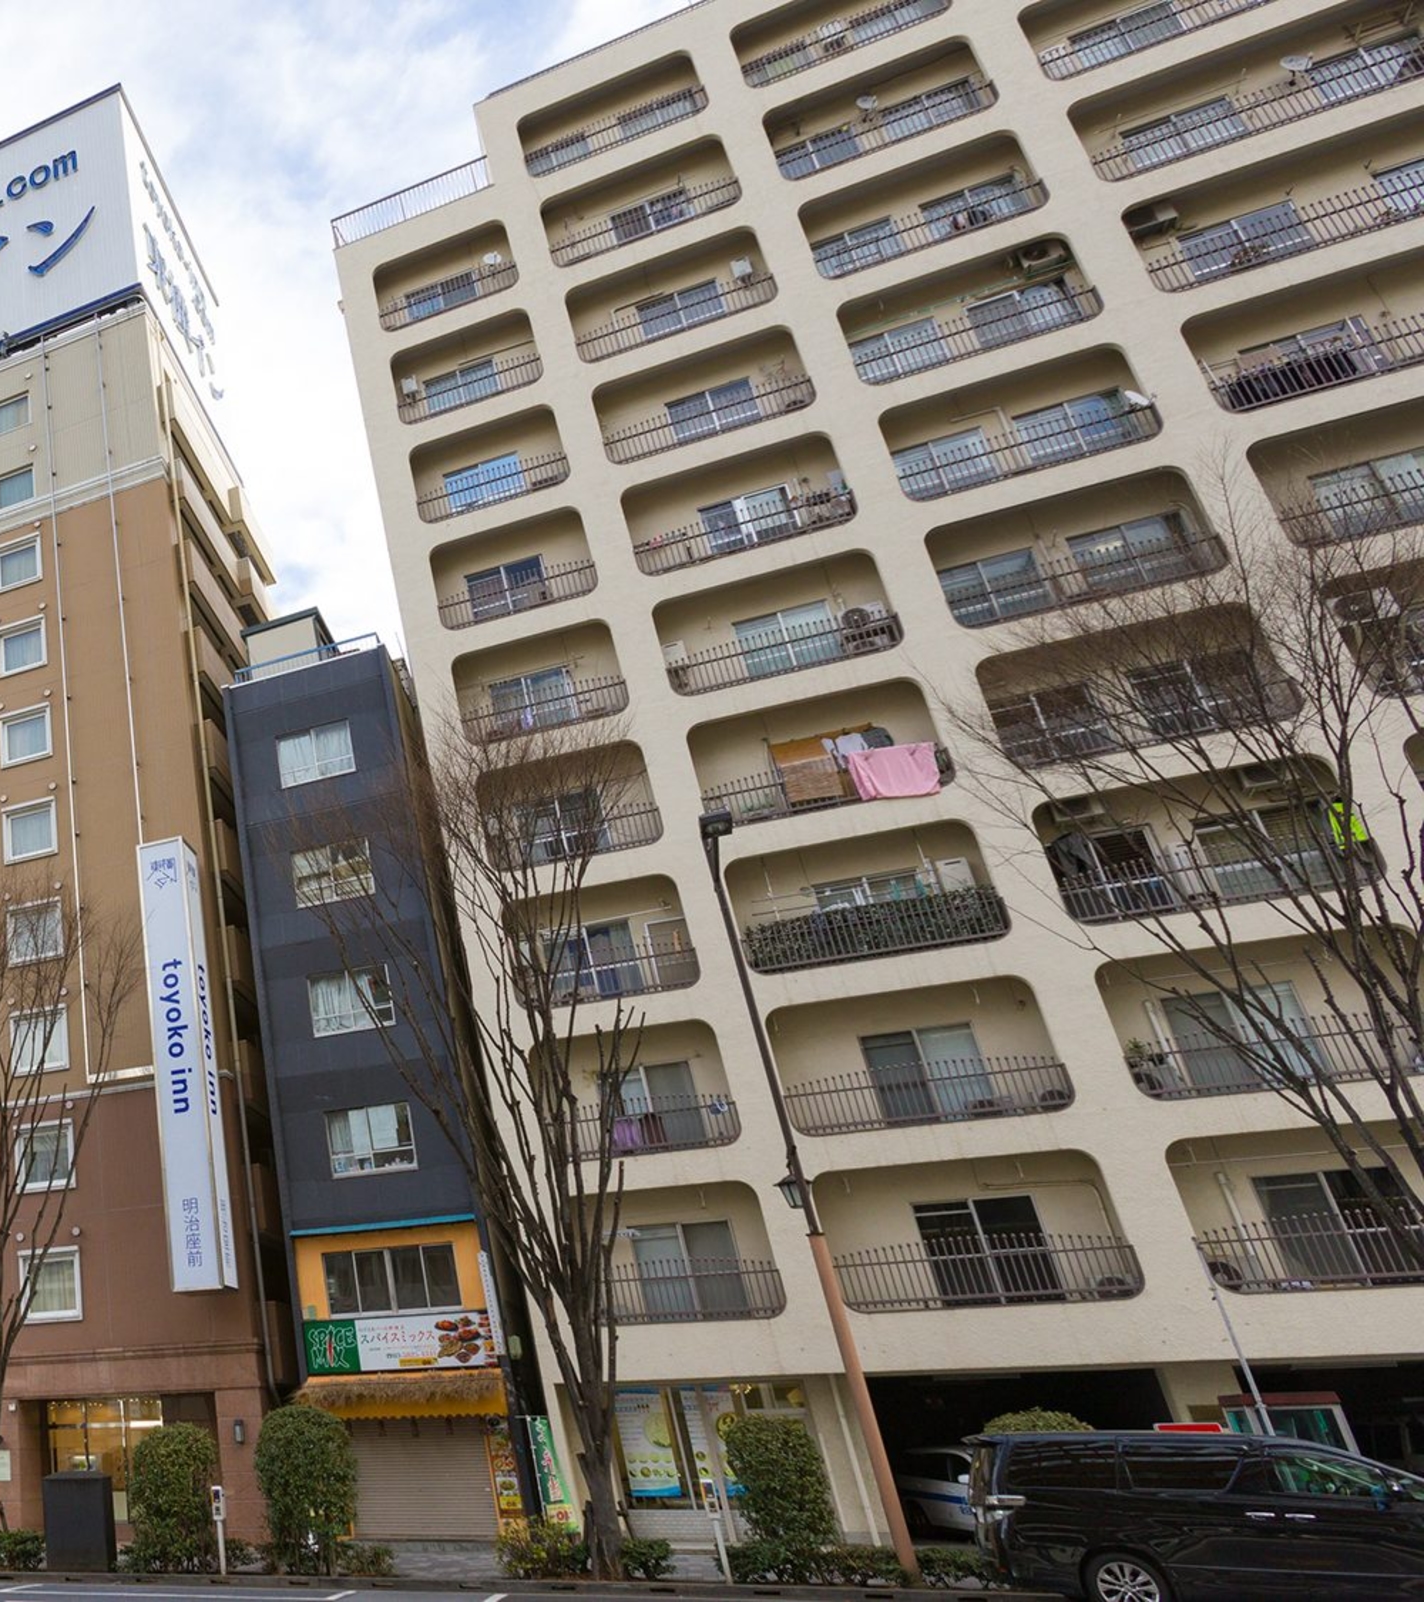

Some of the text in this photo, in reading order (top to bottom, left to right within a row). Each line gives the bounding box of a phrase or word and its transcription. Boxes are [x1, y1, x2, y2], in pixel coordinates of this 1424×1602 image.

[159, 957, 192, 1115] toyoko inn
[182, 1197, 203, 1267] 明治座前
